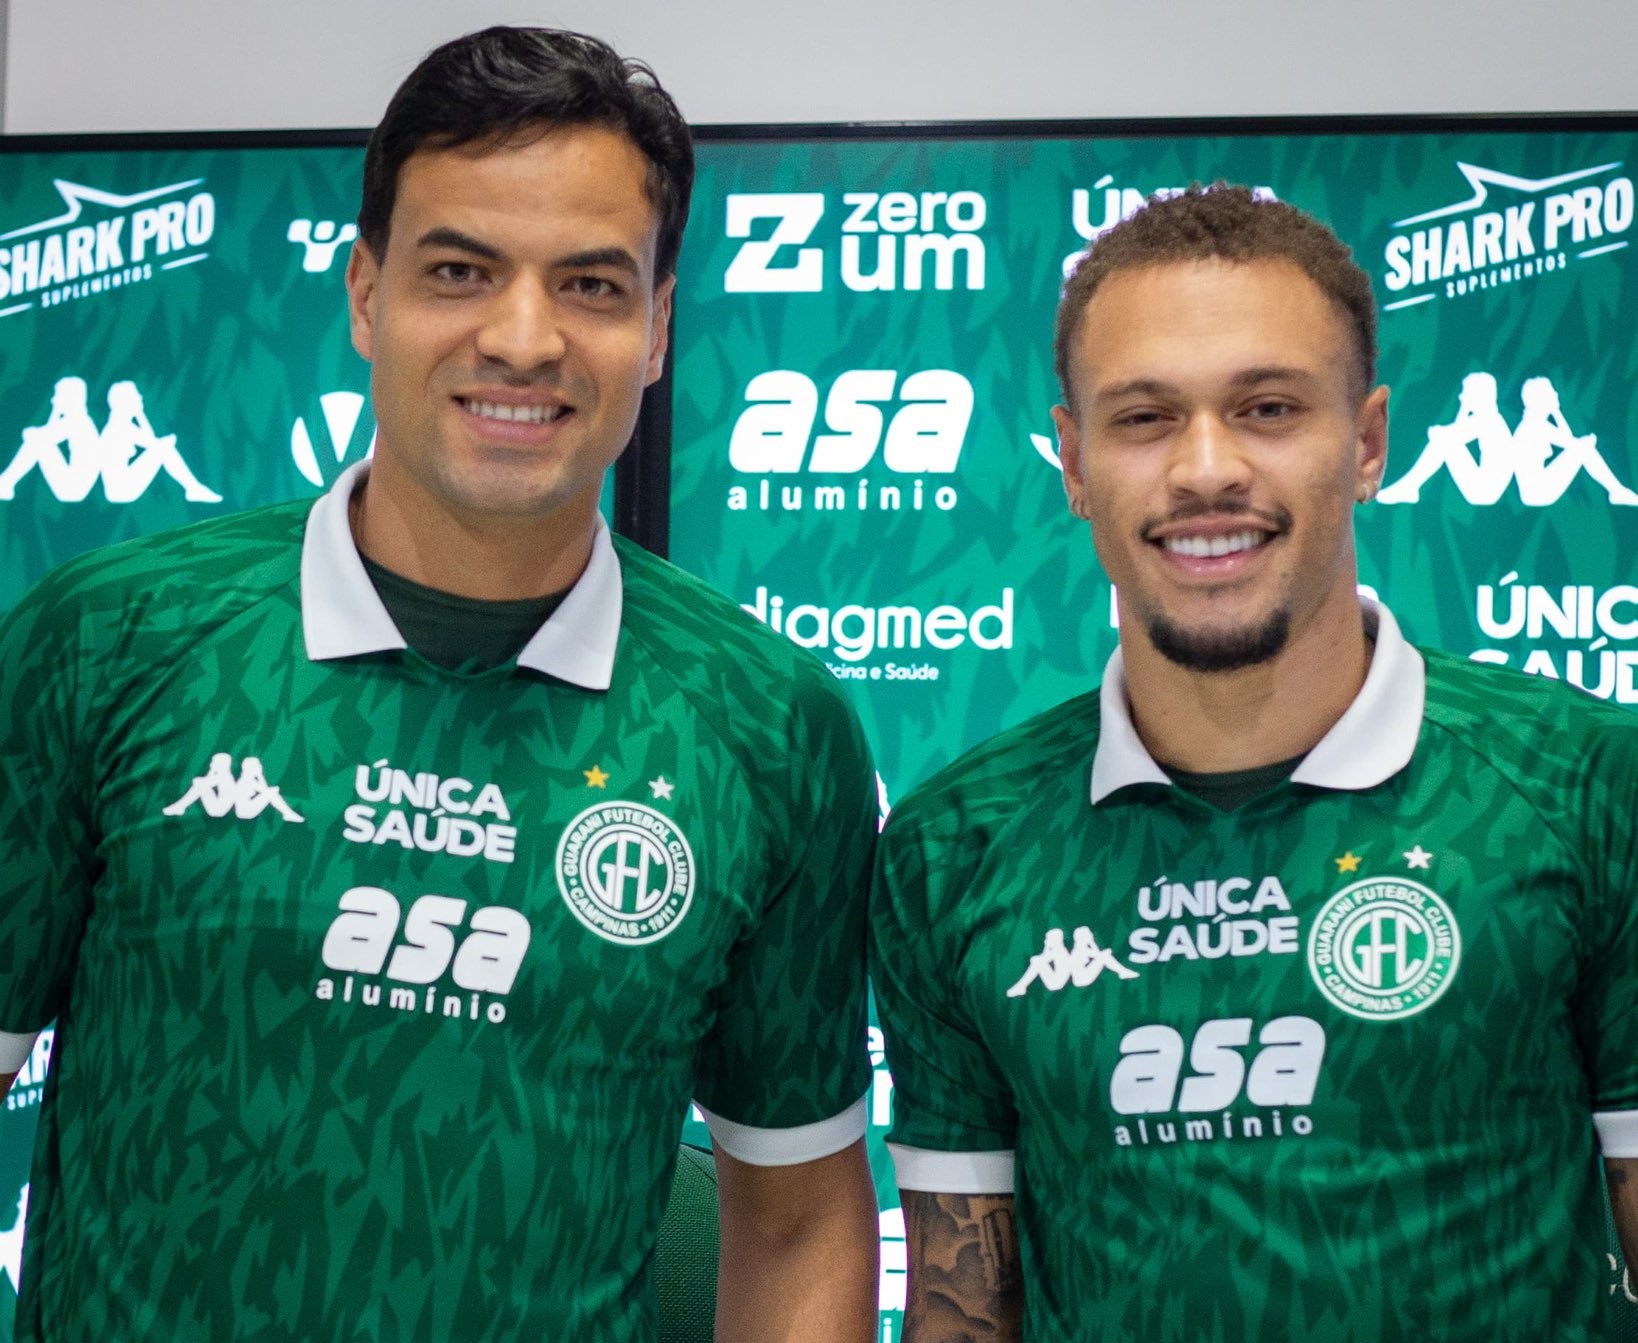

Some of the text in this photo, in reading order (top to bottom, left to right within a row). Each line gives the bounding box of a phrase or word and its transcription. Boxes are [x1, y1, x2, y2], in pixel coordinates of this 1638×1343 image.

[131, 193, 215, 262] PRO
[841, 190, 986, 232] zero
[1384, 177, 1634, 291] SHARK PRO
[725, 193, 824, 292] Z
[841, 233, 985, 291] um
[41, 263, 152, 307] SUPLEMENTOS
[1446, 252, 1567, 298] SUPLEMENTOS
[729, 369, 974, 473] asa
[727, 479, 957, 510] alumínio
[869, 666, 881, 680] e
[885, 662, 939, 681] Saúde
[355, 758, 511, 821] ÚNICA
[342, 804, 517, 863] SAÚDE
[564, 808, 688, 896] GUARANI FUTEBOL CLUBE
[570, 887, 676, 938] CAMPINAS 1911
[1137, 875, 1291, 921] ÚNICA
[1316, 885, 1452, 965] GUARANI FUTEBOL CLUBE
[321, 886, 531, 995] asa
[1128, 912, 1299, 964] SAÚDE
[315, 975, 506, 1024] alumínio
[1325, 971, 1442, 1011] CAMPINAS 1911
[1110, 1015, 1326, 1115] asa
[1114, 1110, 1313, 1146] alumínio
